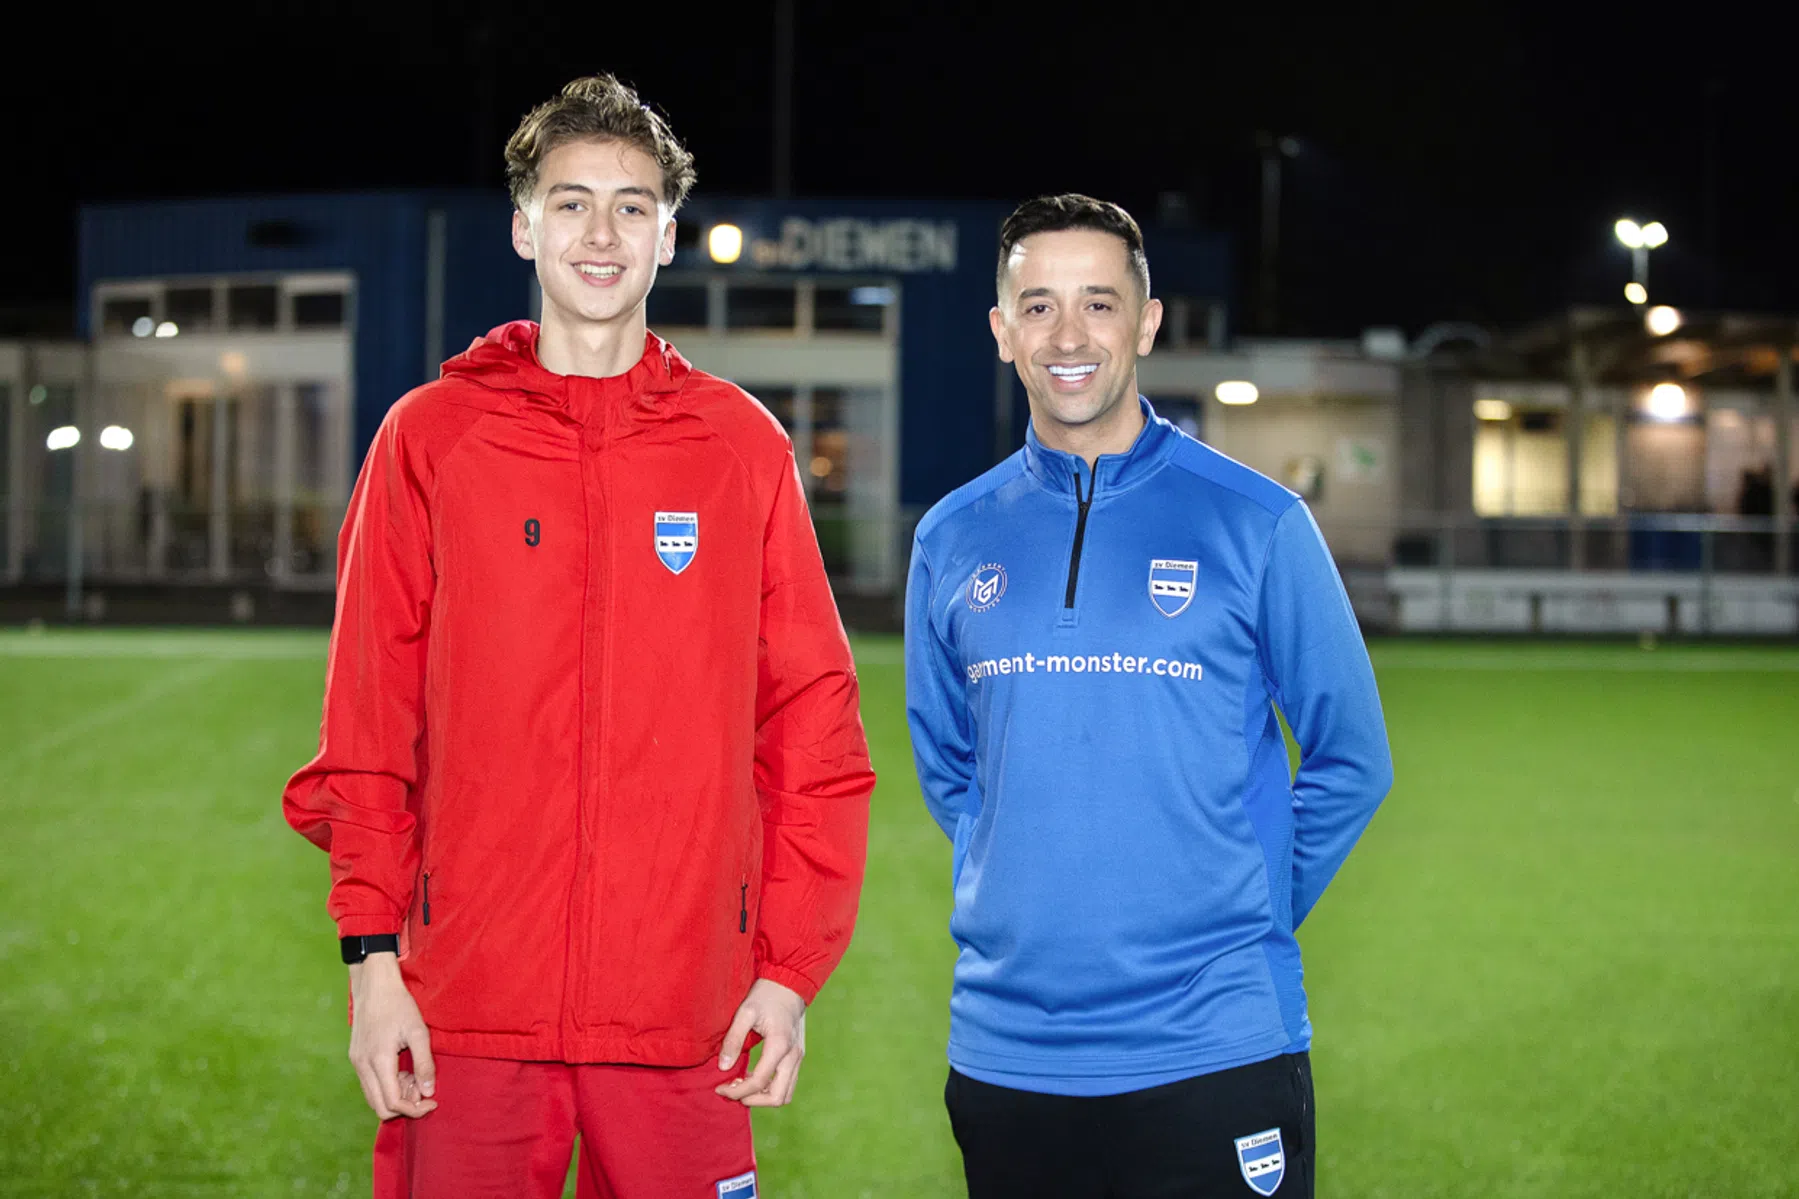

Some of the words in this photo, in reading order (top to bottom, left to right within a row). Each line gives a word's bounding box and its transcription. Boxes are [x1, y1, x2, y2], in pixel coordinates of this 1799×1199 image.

[782, 217, 957, 271] DIEMEN
[667, 514, 695, 522] Diemen
[524, 518, 541, 547] 9
[1165, 561, 1195, 569] Diemen
[1251, 1133, 1278, 1146] Diemen
